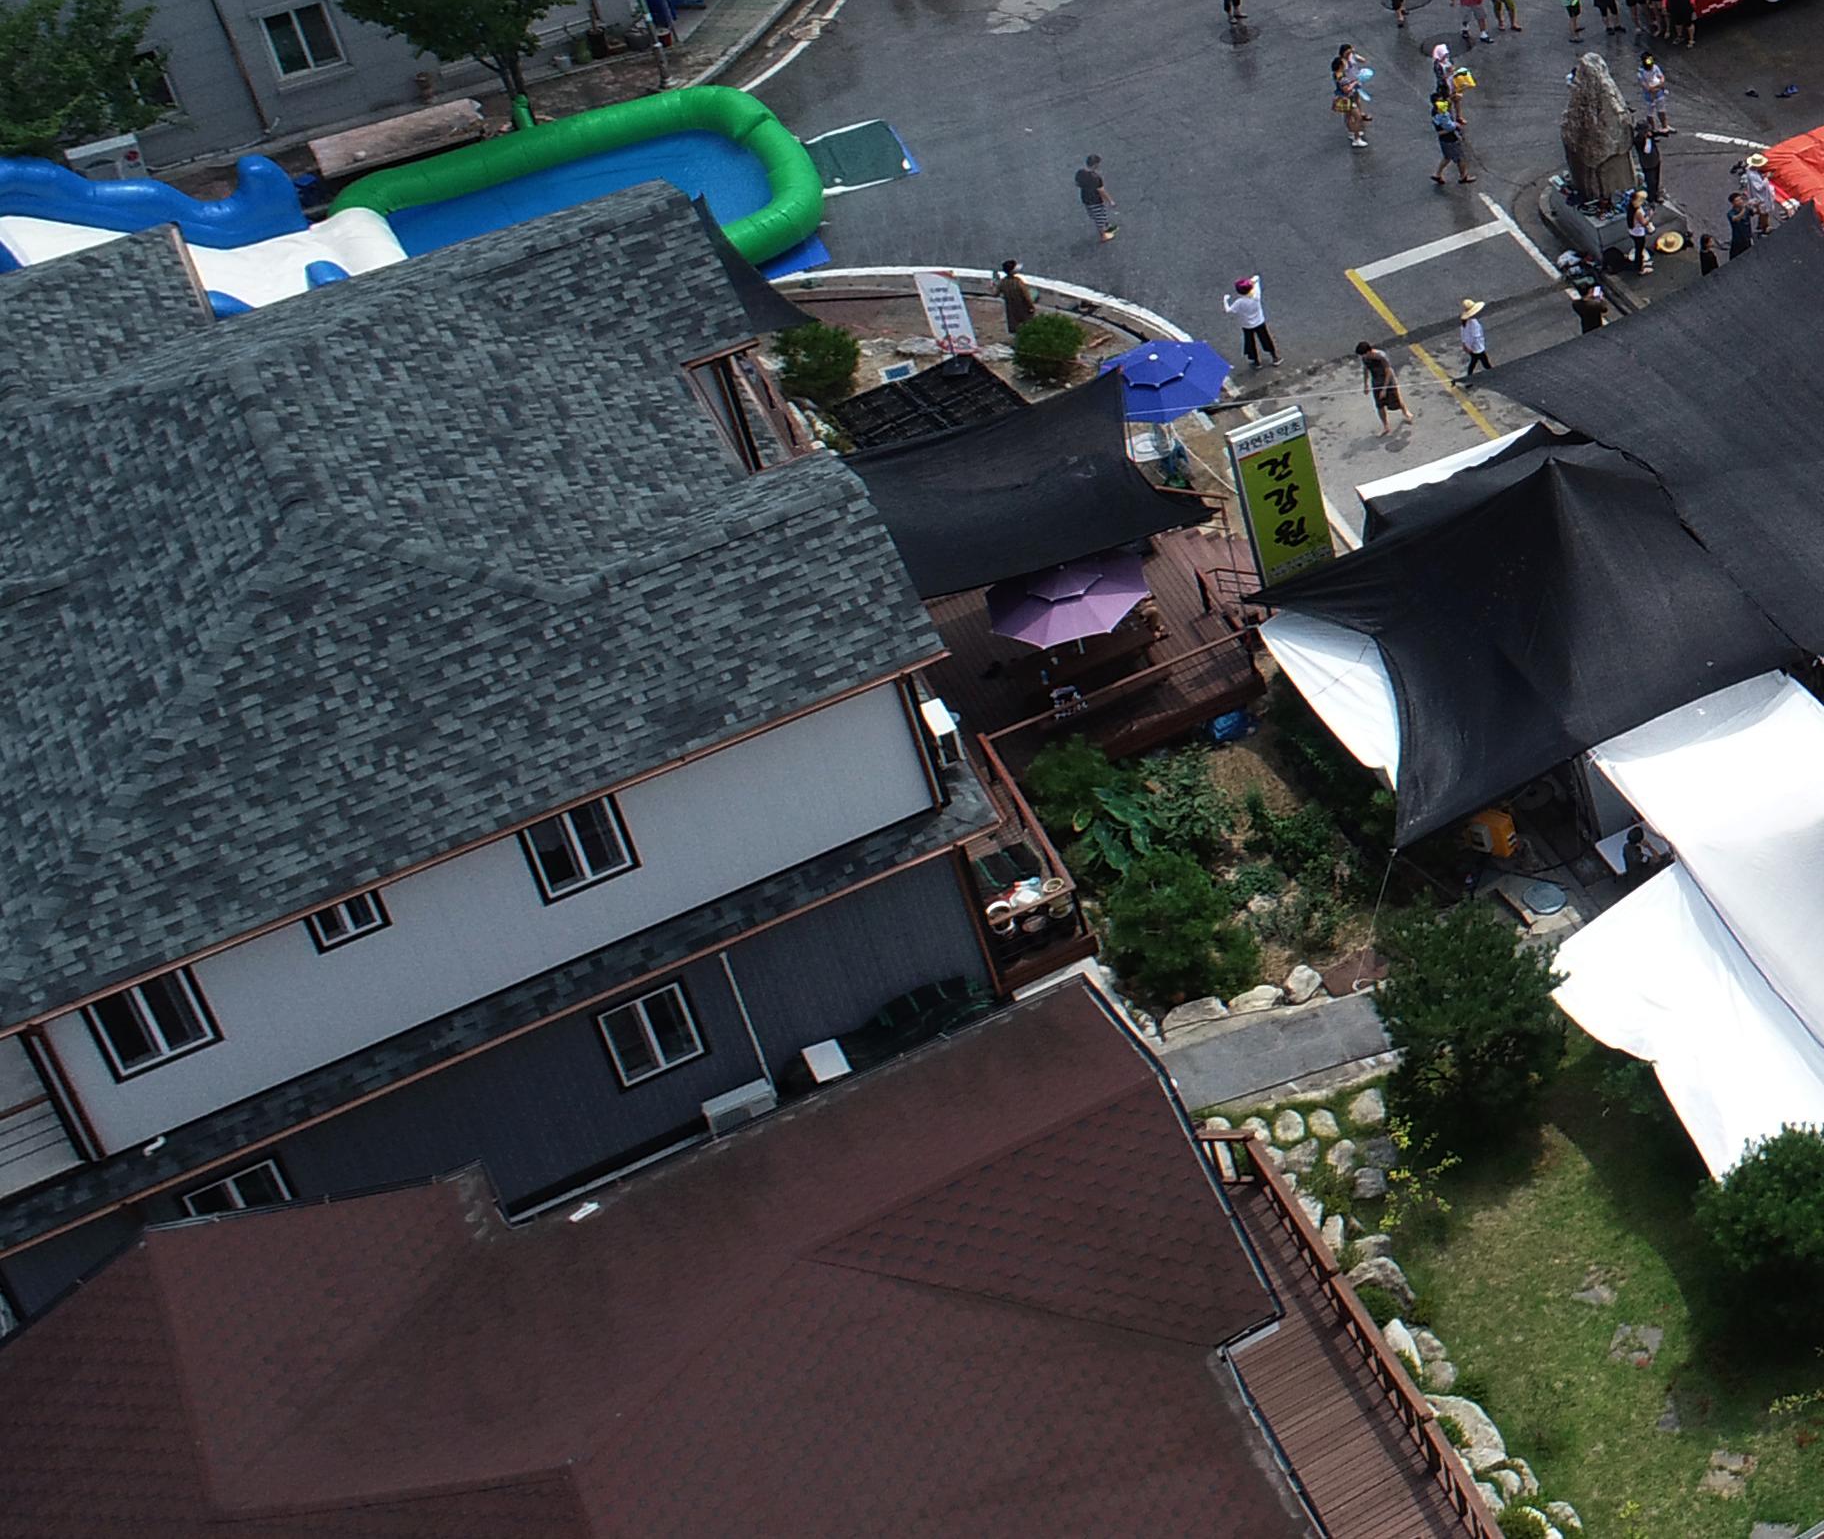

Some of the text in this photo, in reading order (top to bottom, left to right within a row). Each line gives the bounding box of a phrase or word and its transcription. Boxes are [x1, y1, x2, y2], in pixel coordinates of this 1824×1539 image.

[1238, 421, 1302, 453] 자연산 약초
[1256, 450, 1311, 548] 건강원
